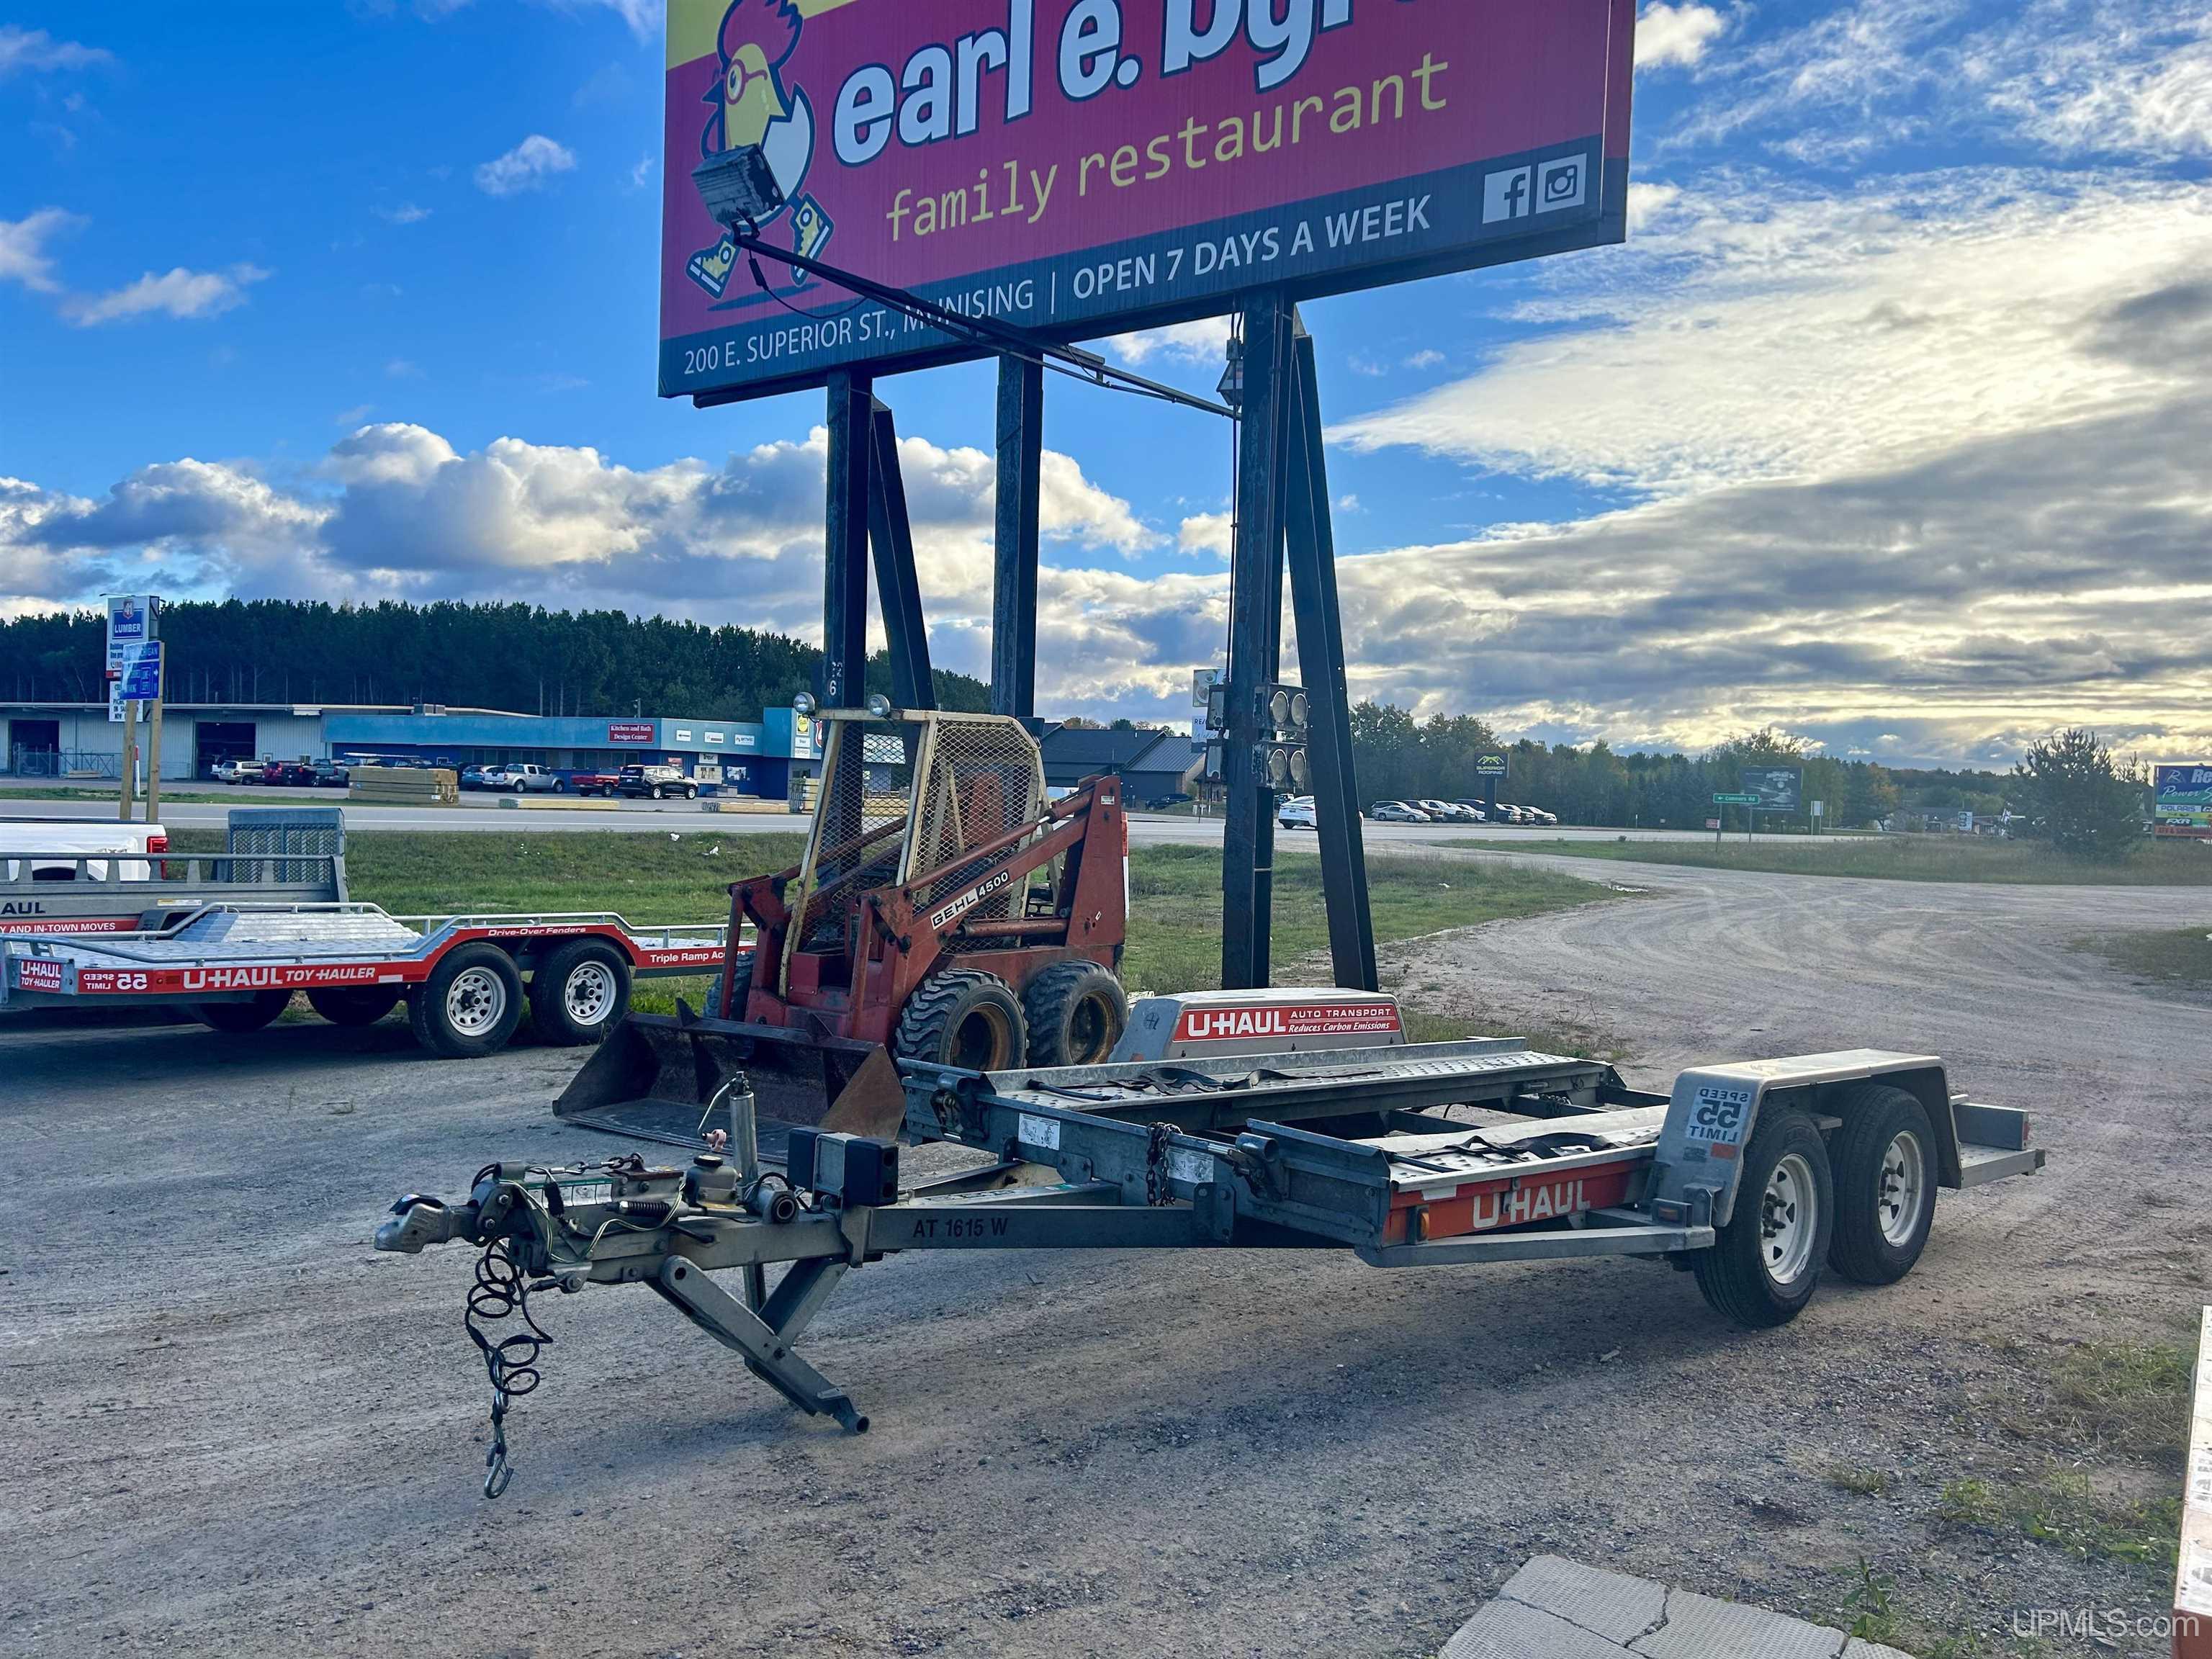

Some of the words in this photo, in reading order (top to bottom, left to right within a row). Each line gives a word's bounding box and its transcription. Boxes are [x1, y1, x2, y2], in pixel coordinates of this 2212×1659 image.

[833, 0, 1034, 166] earl
[1058, 0, 1142, 102] e.
[886, 161, 1058, 241] family
[1080, 53, 1448, 196] restaurant
[1073, 253, 1154, 300] OPEN
[1167, 249, 1184, 280] 7
[1195, 227, 1279, 276] DAYS
[1290, 221, 1314, 256] A
[1326, 194, 1432, 248] WEEK
[684, 346, 718, 374] 200
[725, 341, 740, 367] E.
[747, 317, 851, 364] SUPERIOR
[859, 310, 896, 341] ST.,
[115, 624, 141, 633] LUMBER
[2162, 786, 2200, 799] Power
[932, 896, 976, 927] GEHL
[979, 872, 1008, 896] 4500
[34, 924, 78, 932] IN-TOWN
[650, 953, 678, 963] Triple
[681, 953, 709, 961] Ramp
[20, 961, 61, 977] U-HAUL
[184, 968, 283, 989] U-HAUL
[1188, 1010, 1286, 1037] U-HAUL
[1290, 1010, 1321, 1019] AUTO
[1326, 1009, 1390, 1017] TRANSPORT
[1288, 1023, 1321, 1033] Reduces
[1323, 1022, 1352, 1031] Carbon
[1353, 1021, 1390, 1030] Emissions
[1473, 1179, 1590, 1228] UHAUL
[912, 1219, 938, 1238] AT
[945, 1218, 984, 1237] 1615
[991, 1218, 1008, 1236] W
